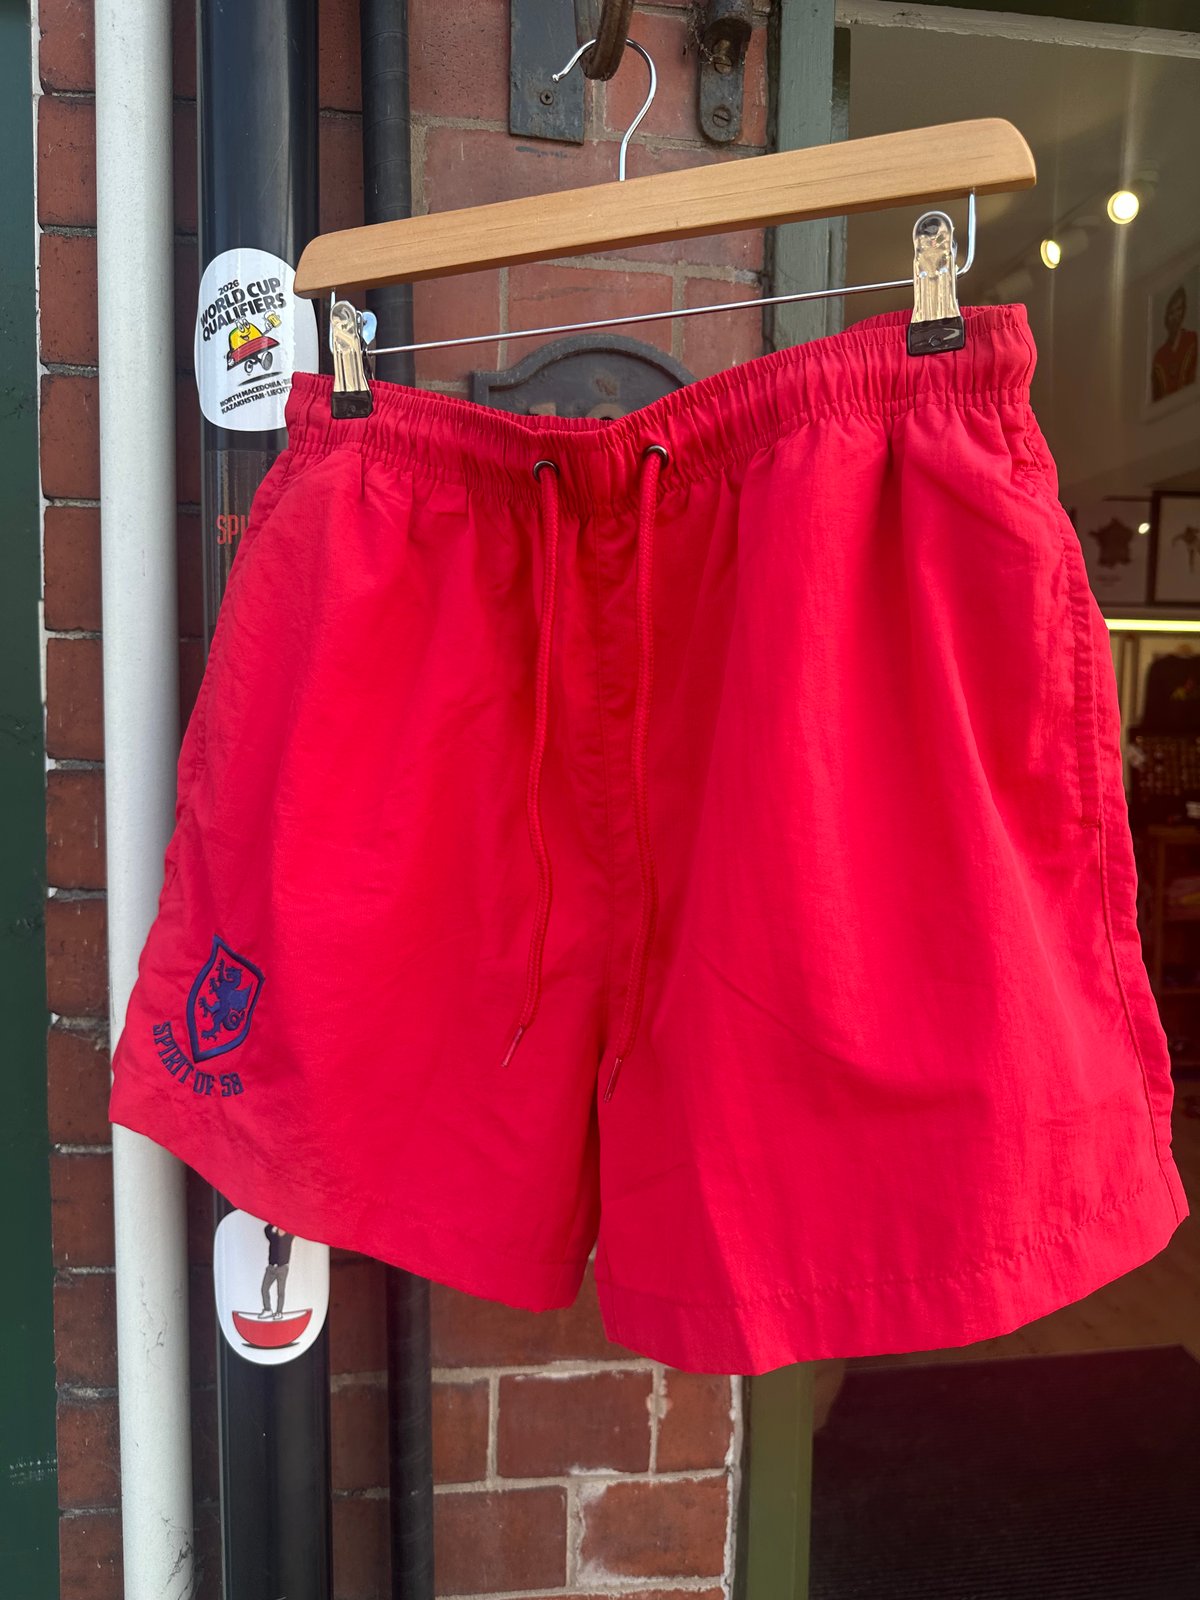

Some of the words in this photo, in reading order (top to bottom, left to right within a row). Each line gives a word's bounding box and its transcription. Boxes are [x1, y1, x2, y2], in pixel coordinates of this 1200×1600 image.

[201, 288, 246, 328] WORLD
[246, 277, 281, 298] CUP
[218, 279, 240, 296] 2026
[203, 292, 287, 341] QUALIFIERS
[219, 393, 242, 407] NORTH
[241, 380, 282, 397] MACEDONIA
[221, 394, 265, 414] KAZAKHSTAN
[266, 386, 291, 398] LIECHT
[216, 514, 250, 545] SPI
[152, 1020, 195, 1084] SPIRIT
[193, 1071, 216, 1095] OF
[219, 1072, 244, 1097] 58
